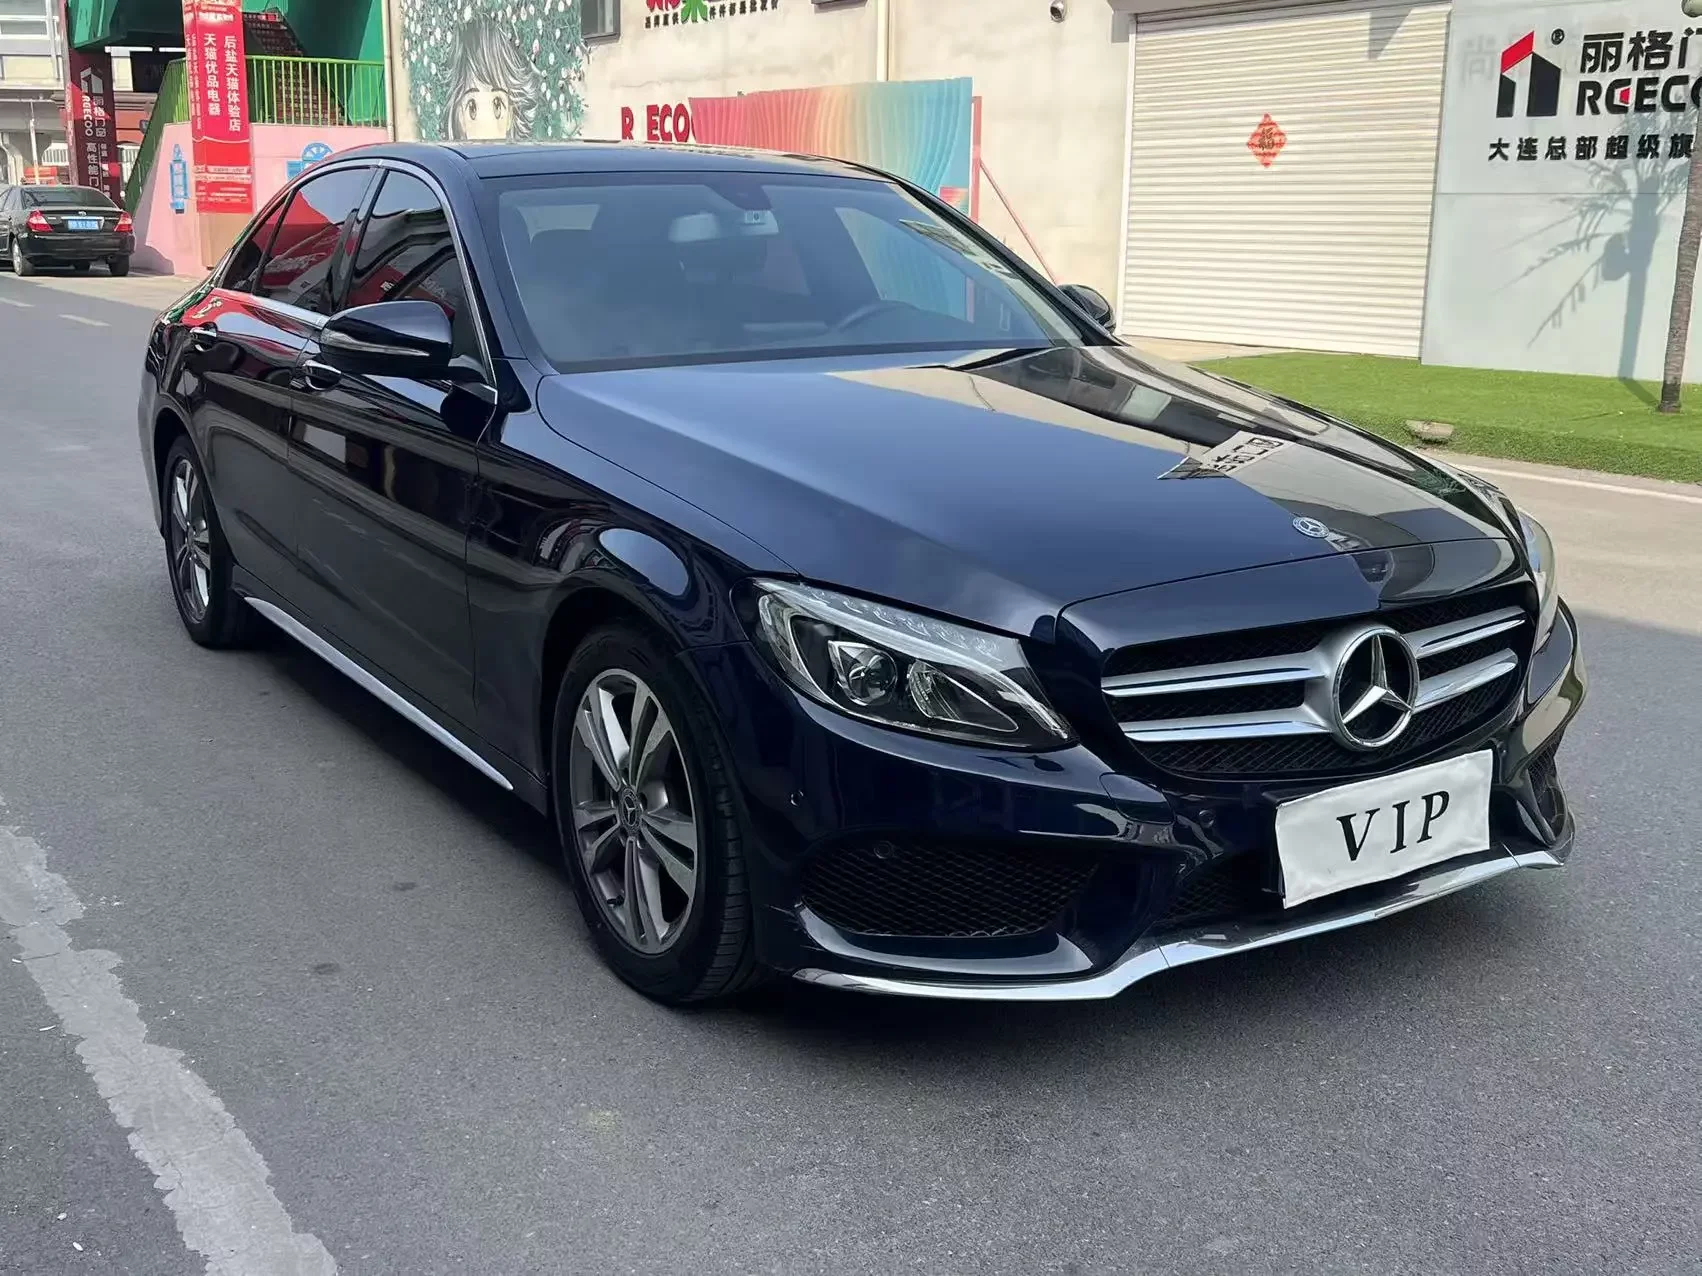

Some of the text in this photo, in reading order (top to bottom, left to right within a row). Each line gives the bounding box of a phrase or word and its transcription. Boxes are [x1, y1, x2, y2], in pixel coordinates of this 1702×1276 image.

[204, 33, 221, 116] 天猫优品电器
[224, 35, 241, 132] 后盐天猫体验店
[1487, 133, 1694, 161] 大连总部超级旗
[1336, 790, 1450, 862] VIP
